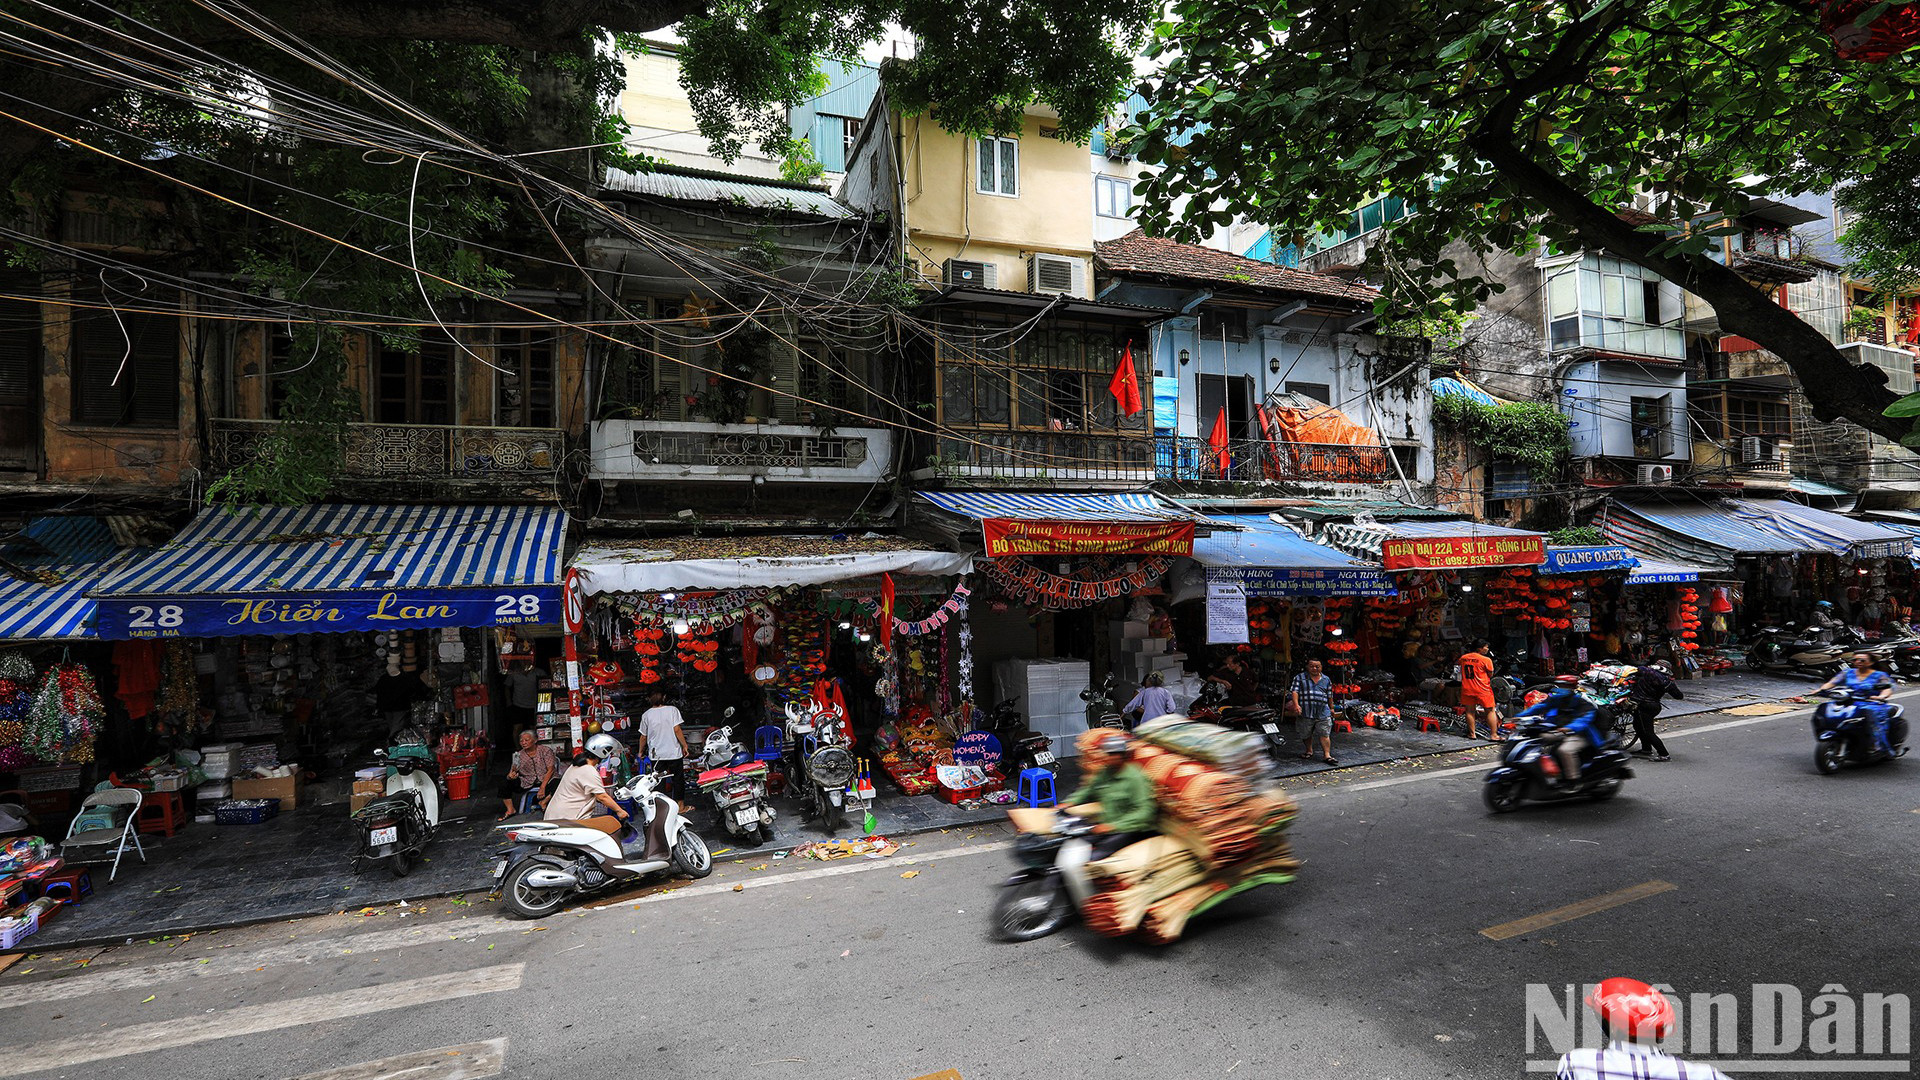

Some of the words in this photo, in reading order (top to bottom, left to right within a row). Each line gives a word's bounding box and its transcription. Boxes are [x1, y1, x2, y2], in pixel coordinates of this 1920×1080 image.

[1097, 525, 1111, 535] 24
[1012, 540, 1050, 553] TRANG
[1075, 540, 1104, 553] SINH
[1435, 543, 1452, 555] 22A
[1521, 539, 1539, 552] LÂN
[1445, 556, 1469, 565] 0982
[1470, 555, 1486, 564] 835
[1488, 554, 1504, 563] 133
[1556, 550, 1592, 567] QUANG
[999, 554, 1063, 594] HAPPY
[1067, 554, 1177, 600] HALLOWEEN
[1338, 571, 1357, 579] NGA
[1659, 575, 1682, 583] HOA
[1685, 574, 1697, 582] 18
[945, 583, 972, 614] DAY
[128, 605, 184, 628] 28
[366, 592, 458, 620] Lan
[494, 594, 540, 616] 28
[962, 734, 990, 743] HAPPY
[953, 744, 986, 755] WOMEN'S
[983, 751, 1001, 760] DAY
